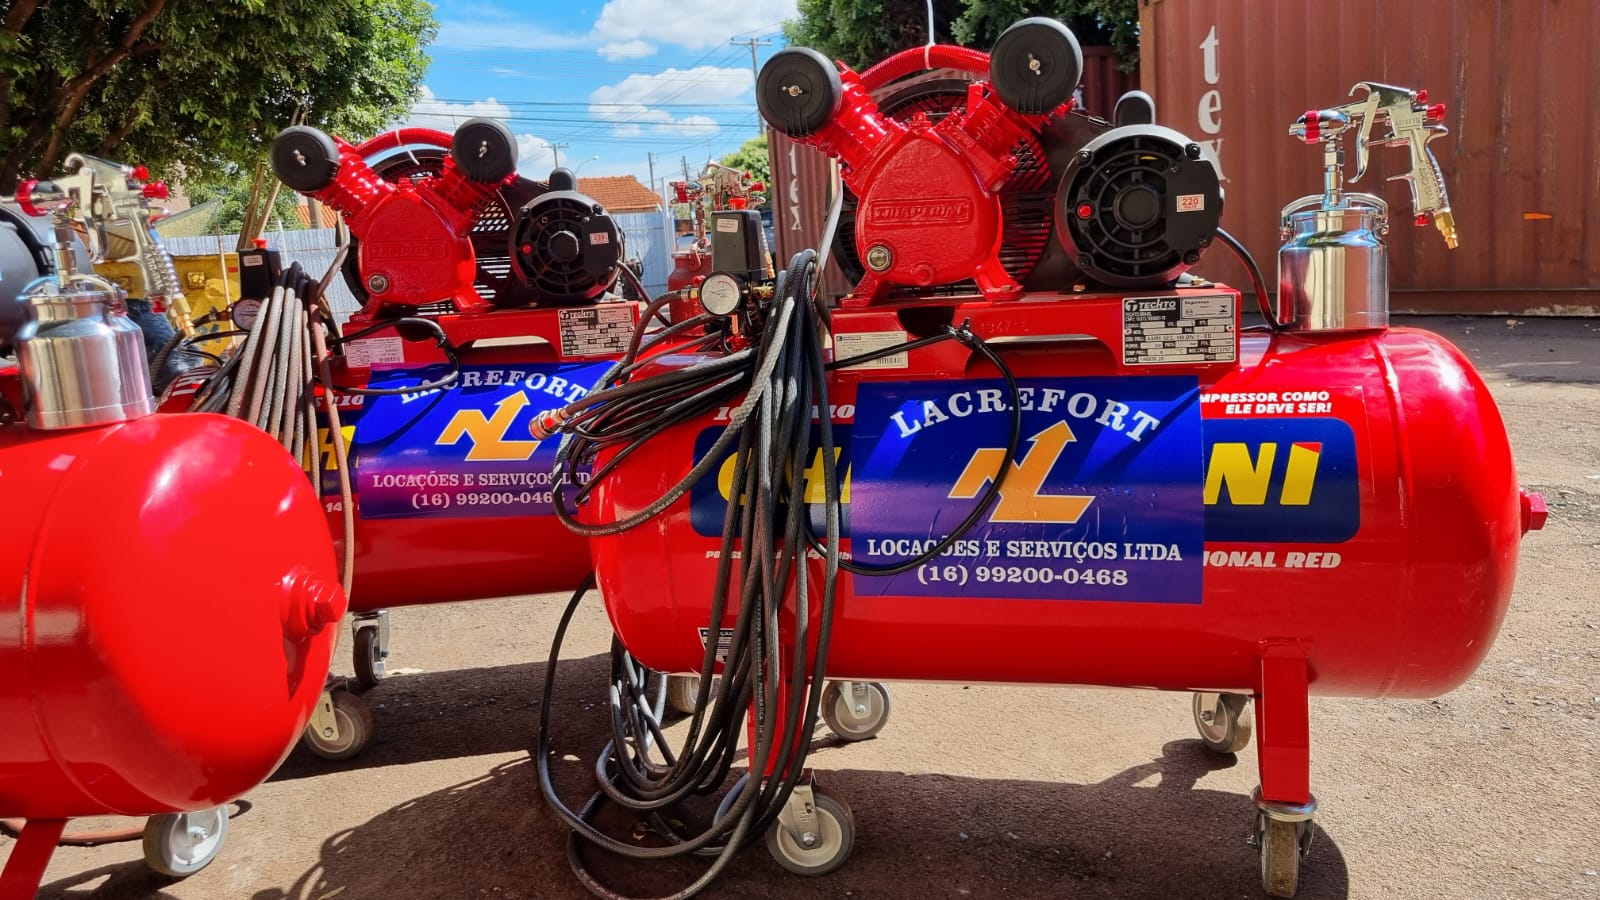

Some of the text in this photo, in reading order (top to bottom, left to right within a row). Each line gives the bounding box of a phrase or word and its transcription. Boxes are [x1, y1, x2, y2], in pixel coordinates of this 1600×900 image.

[1183, 197, 1199, 205] 220
[1139, 299, 1176, 309] TECHTO
[1282, 391, 1330, 402] COMO
[890, 387, 1160, 443] LACREFORT
[1225, 402, 1332, 414] ELE DEVE SER!
[373, 470, 460, 491] LOCAÇÕES
[464, 474, 474, 486] E
[412, 491, 565, 509] (16) 99200-046
[986, 541, 1000, 556] E
[1006, 541, 1118, 563] SERVIÇOS
[1124, 543, 1183, 561] LTDA
[1284, 552, 1342, 568] RED
[917, 564, 1129, 586] (16) 99200-0468
